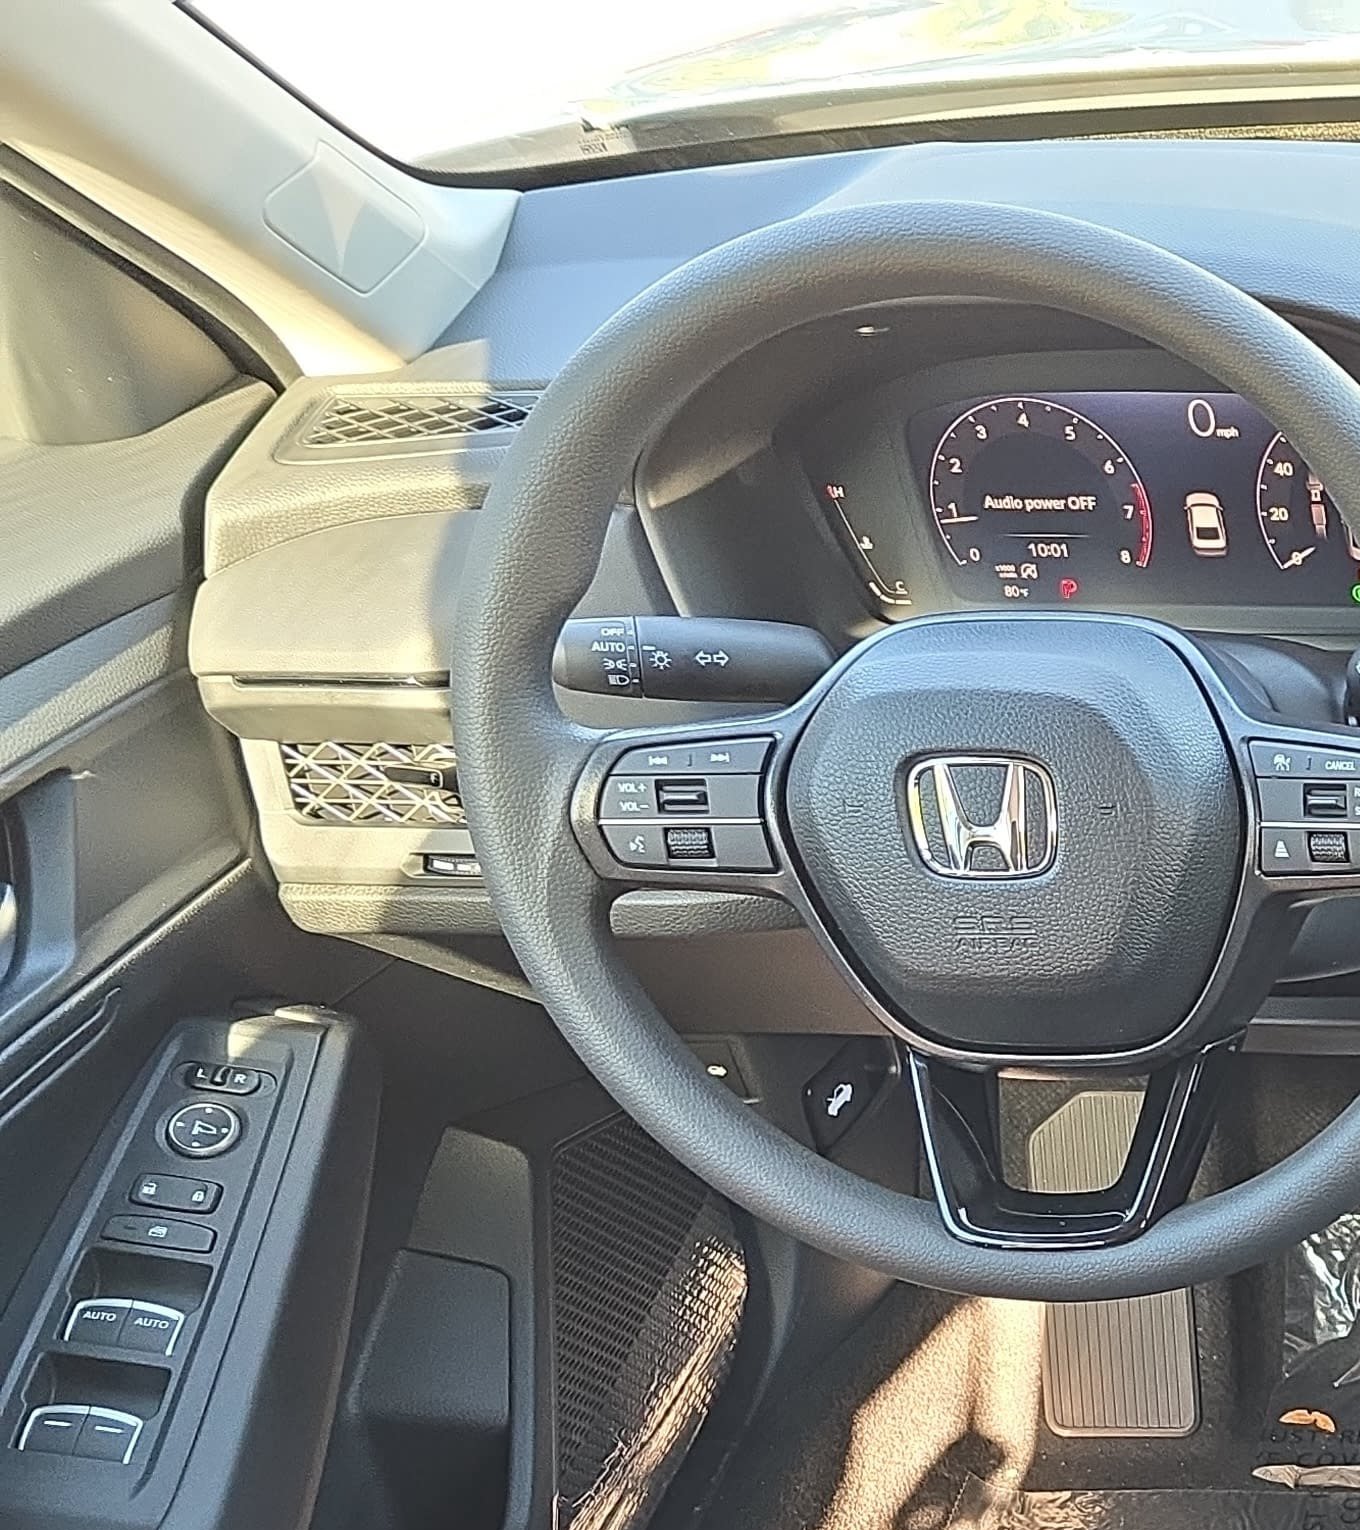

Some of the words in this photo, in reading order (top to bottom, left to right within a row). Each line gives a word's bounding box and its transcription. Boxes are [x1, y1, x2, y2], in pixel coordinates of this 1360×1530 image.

[1017, 412, 1029, 427] 4
[1188, 399, 1216, 438] 0
[1216, 426, 1239, 439] mph
[976, 425, 988, 440] 3
[1064, 426, 1076, 441] 5
[949, 458, 963, 474] 2
[1103, 460, 1115, 475] 6
[1274, 462, 1294, 477] 40
[948, 502, 958, 518] 1
[984, 495, 1023, 509] Audio
[1025, 498, 1067, 512] power
[1067, 496, 1097, 510] OFF
[1123, 504, 1134, 520] 7
[1269, 506, 1289, 521] 20
[969, 548, 981, 562] 0
[1028, 543, 1070, 558] 10:01
[1120, 549, 1132, 564] 8
[1060, 579, 1078, 599] P
[601, 627, 625, 637] OFF
[591, 641, 626, 653] AUTO
[1325, 760, 1356, 771] CANCEL
[197, 1068, 208, 1079] L
[234, 1073, 246, 1084] R
[82, 1310, 117, 1322] AUTO
[133, 1316, 170, 1329] AUTO
